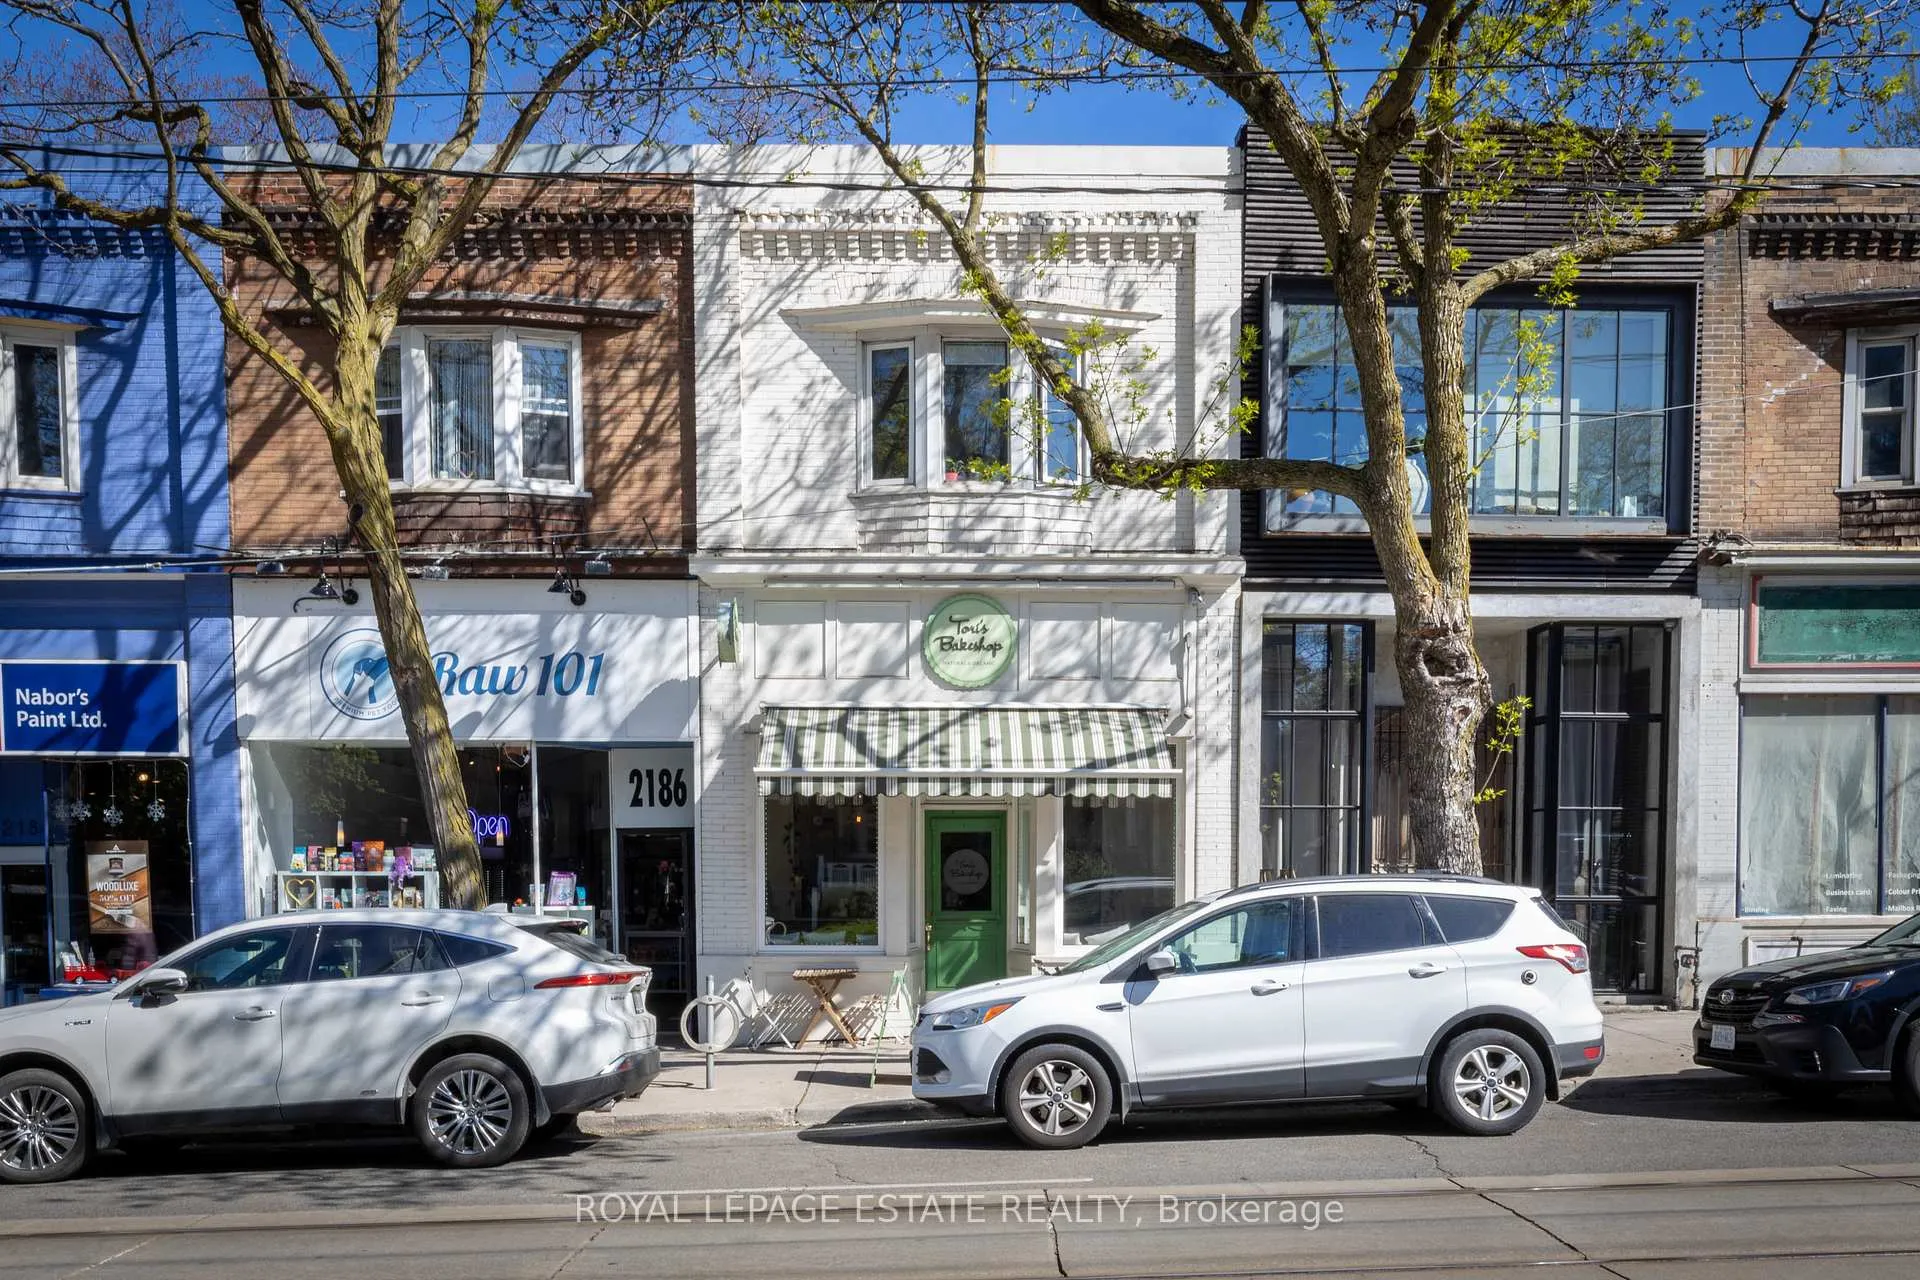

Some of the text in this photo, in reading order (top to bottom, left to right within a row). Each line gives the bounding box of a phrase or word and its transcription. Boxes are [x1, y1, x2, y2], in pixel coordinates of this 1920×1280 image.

[949, 616, 989, 635] Tori's
[933, 636, 1003, 658] Bakeshop
[432, 651, 604, 696] Raw 101
[16, 688, 89, 705] Nabor's
[16, 710, 107, 728] Paint Ltd.
[629, 768, 688, 807] 2186
[96, 880, 139, 892] WOODLUXE
[1826, 888, 1854, 896] Business
[1888, 888, 1910, 896] Colour
[1888, 904, 1915, 912] Mailbox
